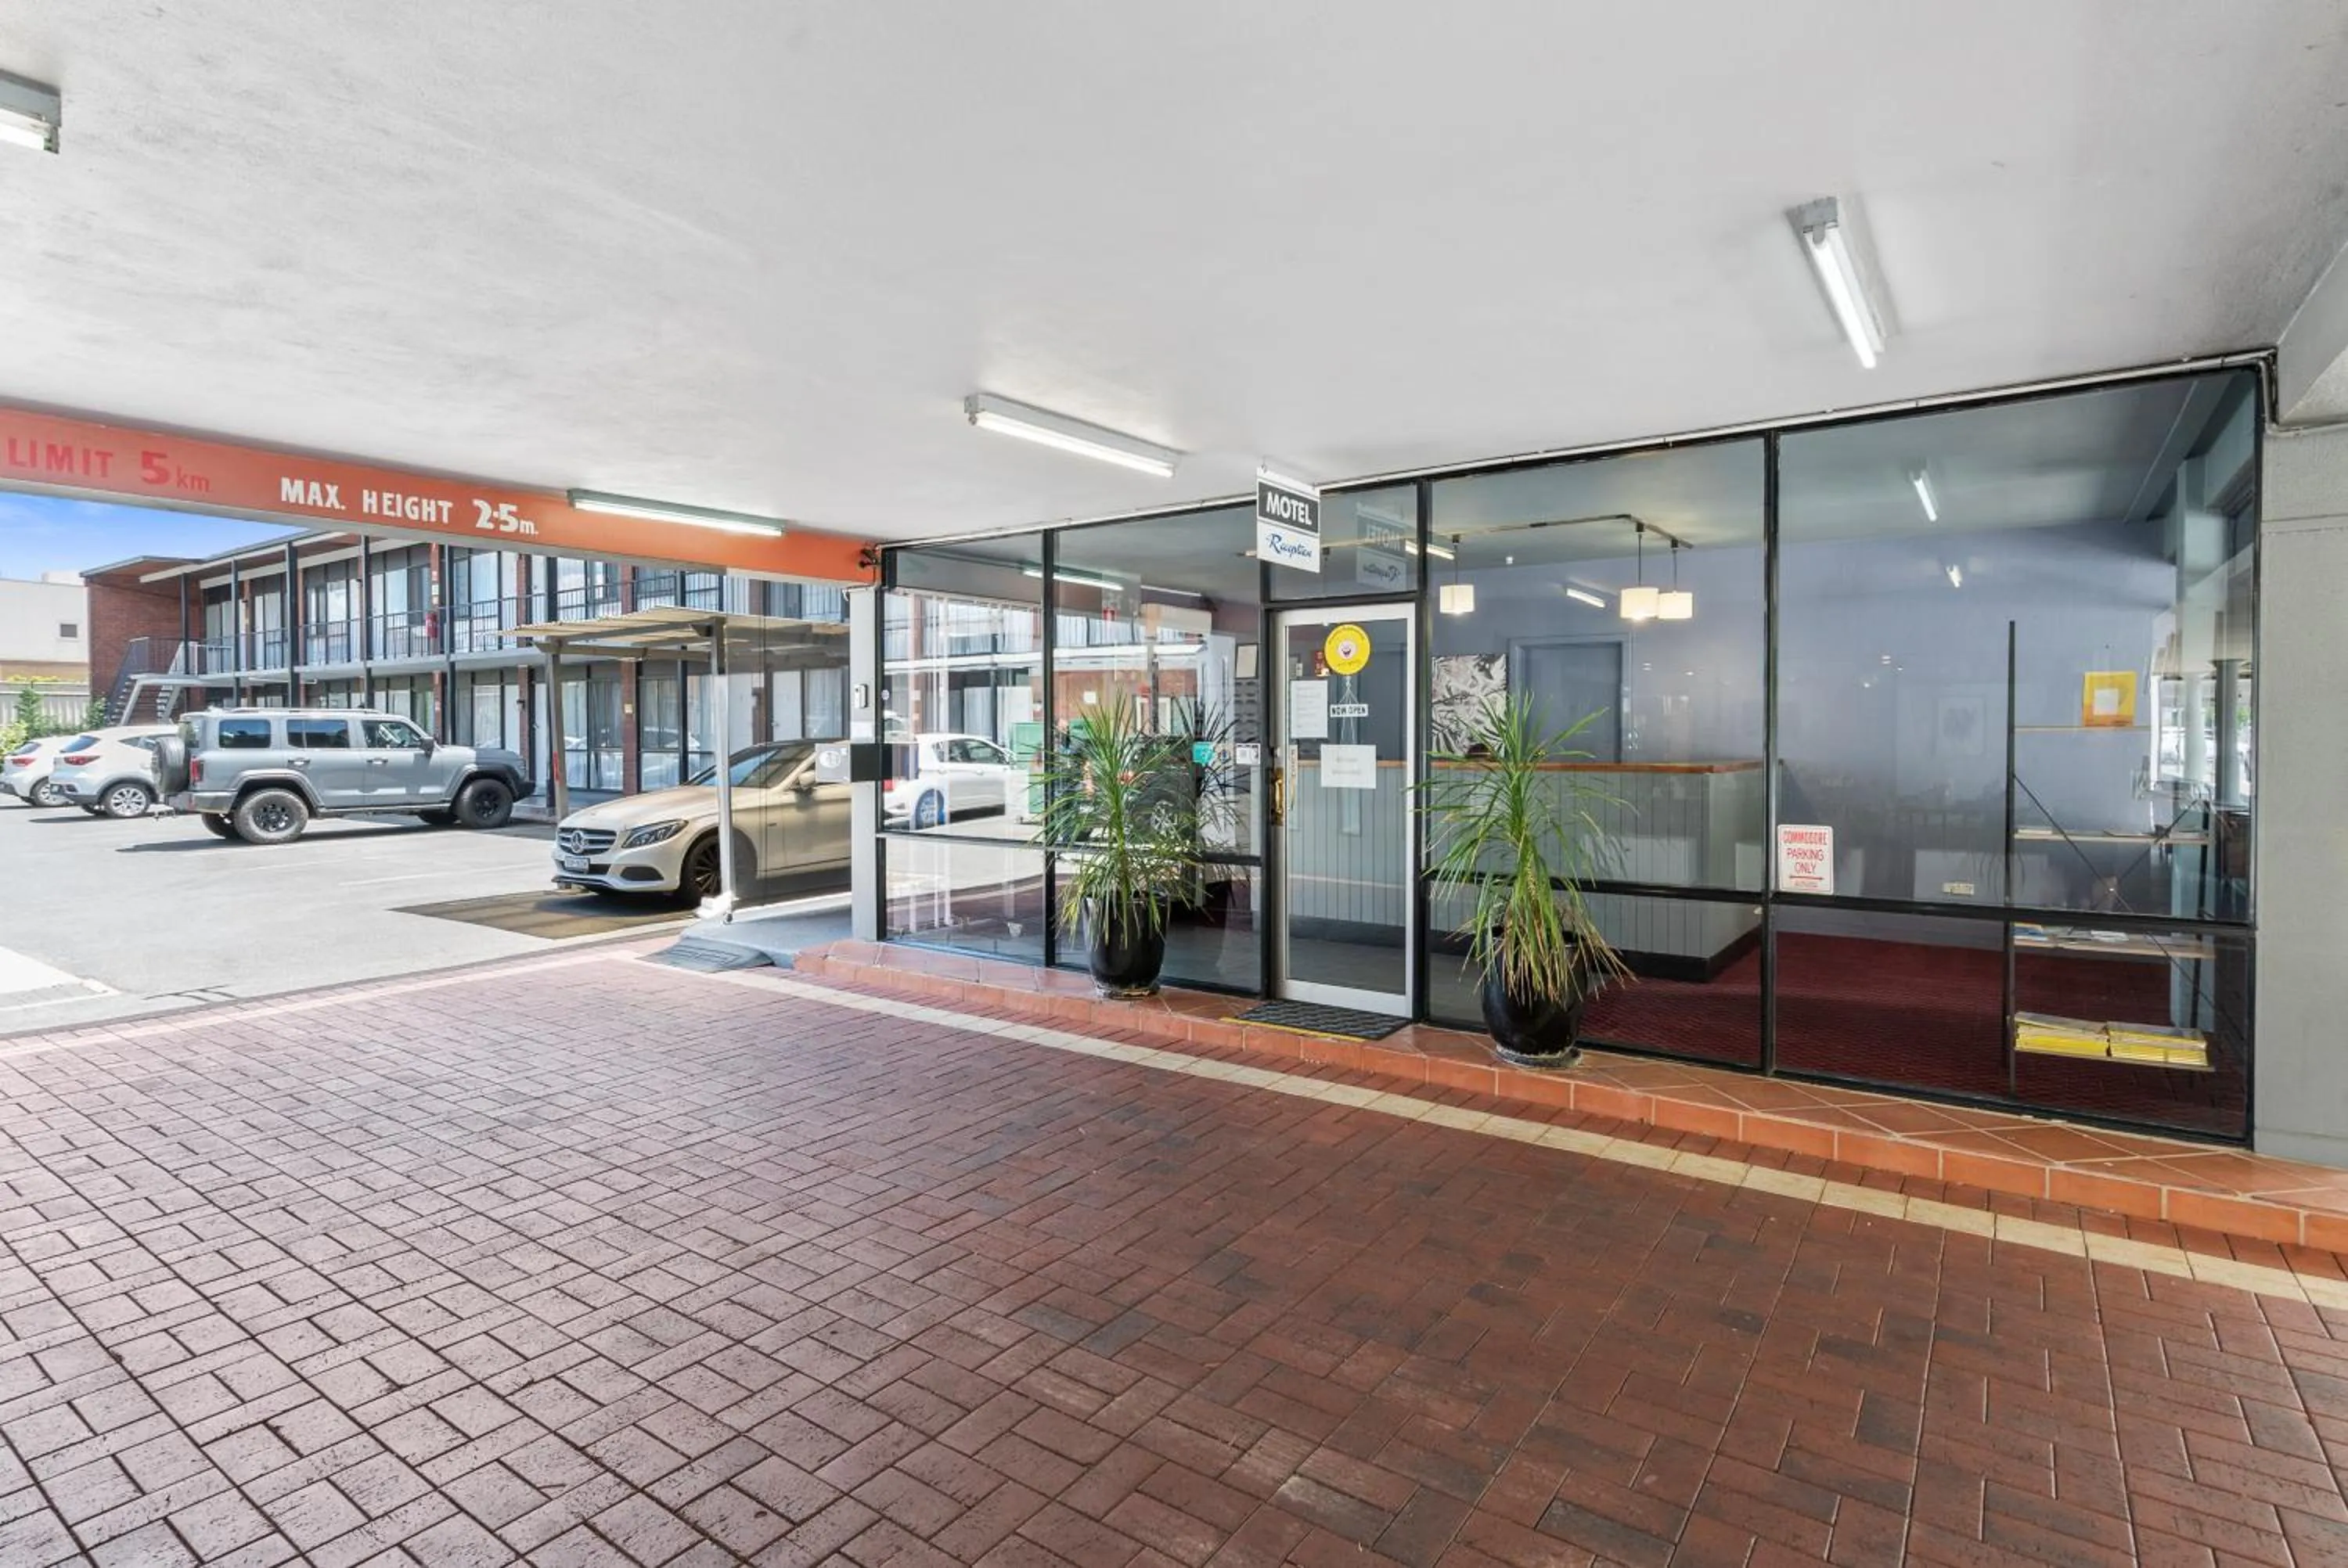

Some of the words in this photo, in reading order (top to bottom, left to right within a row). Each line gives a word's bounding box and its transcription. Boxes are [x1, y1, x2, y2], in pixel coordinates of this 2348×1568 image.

[7, 437, 113, 478] LIMIT
[362, 489, 453, 524] HEIGHT
[1266, 491, 1313, 525] MOTEL
[1266, 532, 1313, 558] Reception
[1787, 847, 1824, 861] PARKING
[1795, 861, 1817, 874] ONLY
